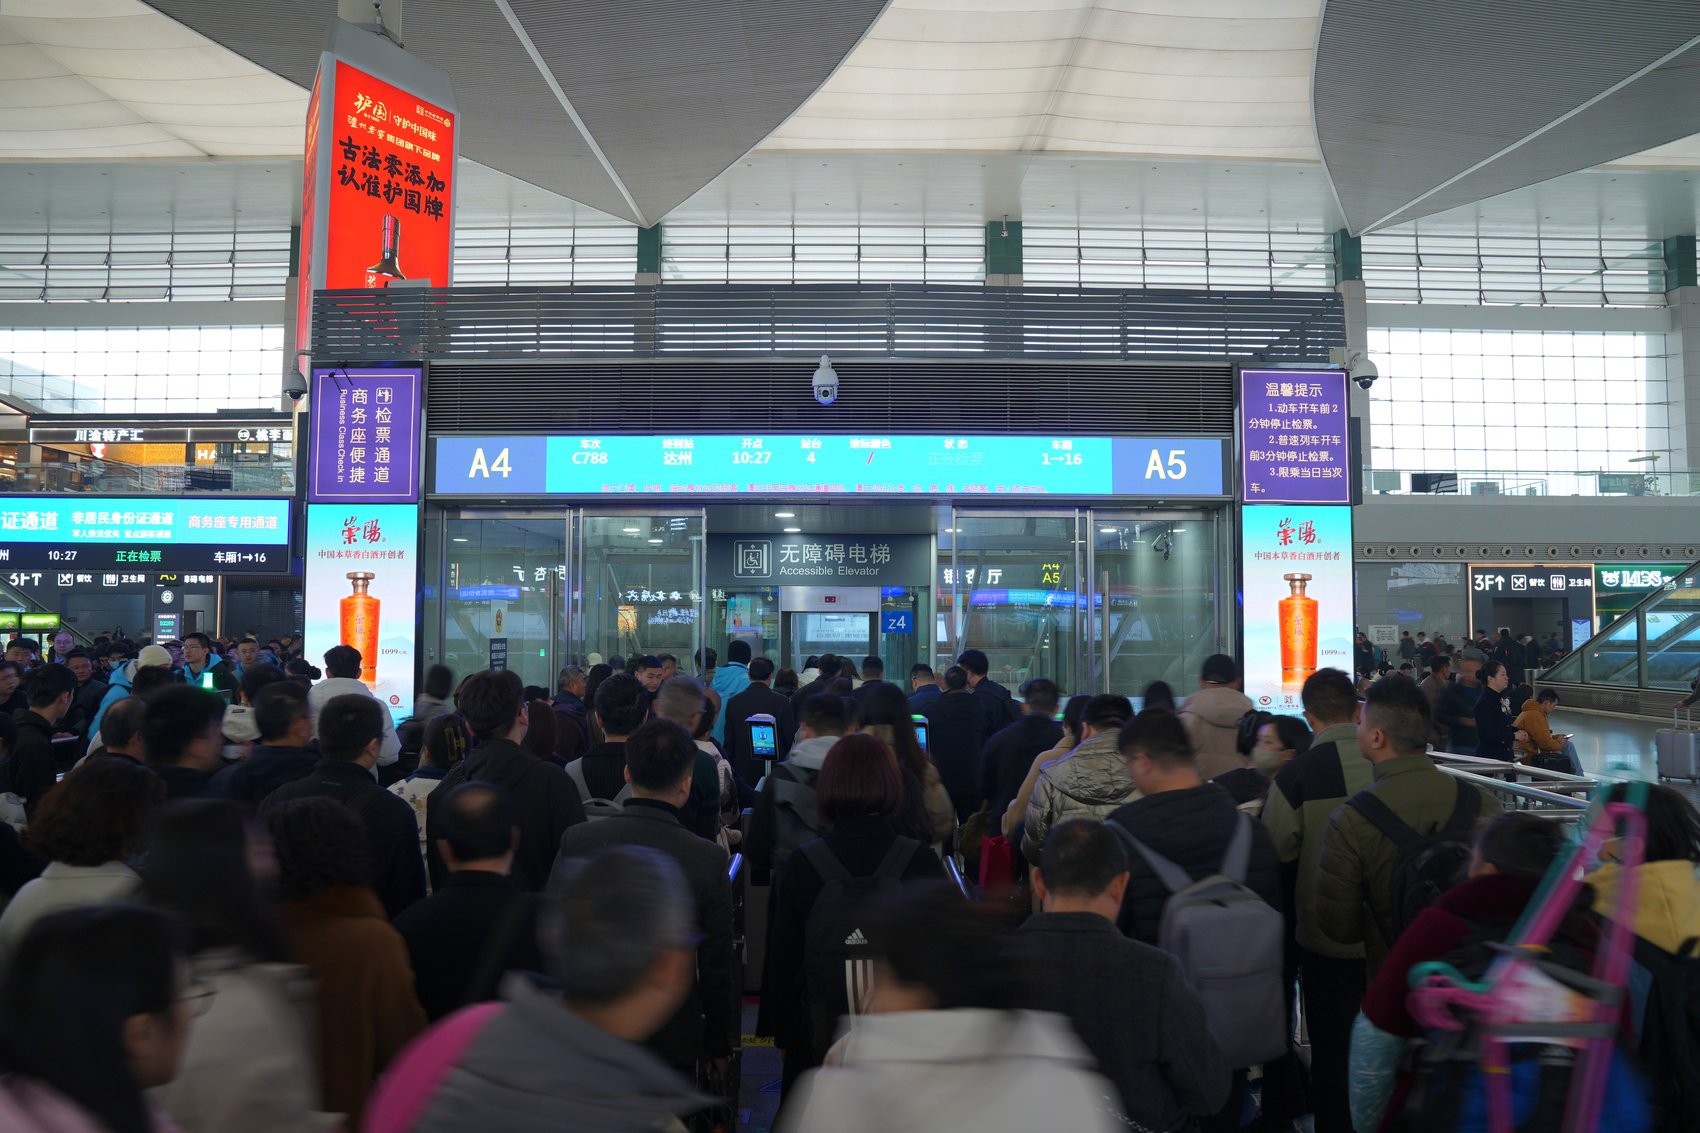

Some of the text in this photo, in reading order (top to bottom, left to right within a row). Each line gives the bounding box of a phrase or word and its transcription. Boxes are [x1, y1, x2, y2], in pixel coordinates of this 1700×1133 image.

[393, 114, 437, 142] 守护中国味
[339, 136, 446, 194] 古法零添加
[337, 165, 444, 222] 认准护国牌
[1265, 382, 1323, 398] 温馨提示
[1248, 417, 1318, 430] 分钟停止检票。
[74, 429, 145, 442] 川渝特产汇
[338, 426, 347, 449] Class
[349, 388, 369, 484] 商务座便捷
[1268, 434, 1342, 446] 2.普速列车开车
[374, 407, 393, 483] 检票通道
[580, 438, 602, 450] 车次
[741, 438, 764, 450] 开点
[800, 438, 823, 450] 站台
[337, 450, 346, 474] Check
[468, 447, 513, 479] A4
[571, 451, 609, 465] C788
[663, 451, 694, 466] 达州
[732, 451, 772, 465] 10:27
[806, 451, 817, 465] 4
[1249, 449, 1334, 462] 前3分钟停止检票。
[1145, 448, 1188, 480] A5
[1269, 467, 1343, 478] 3.限乘当日当次
[1250, 482, 1266, 494] 车。
[1, 511, 279, 530] 证通道 非居民身份证通道 商务座专用通道
[47, 550, 78, 562] 10:27
[115, 549, 163, 563] 正在检票
[318, 549, 406, 560] 中国本草香白酒开创者
[779, 543, 891, 565] 无障碍电梯
[1254, 550, 1341, 561] 中国本草香白酒开创者
[76, 573, 93, 584] 餐饮
[121, 573, 146, 584] 卫生间
[779, 566, 880, 577] Accessible Elevator
[1042, 572, 1060, 584] A5
[1474, 575, 1592, 591] 3F 餐饮 卫生间
